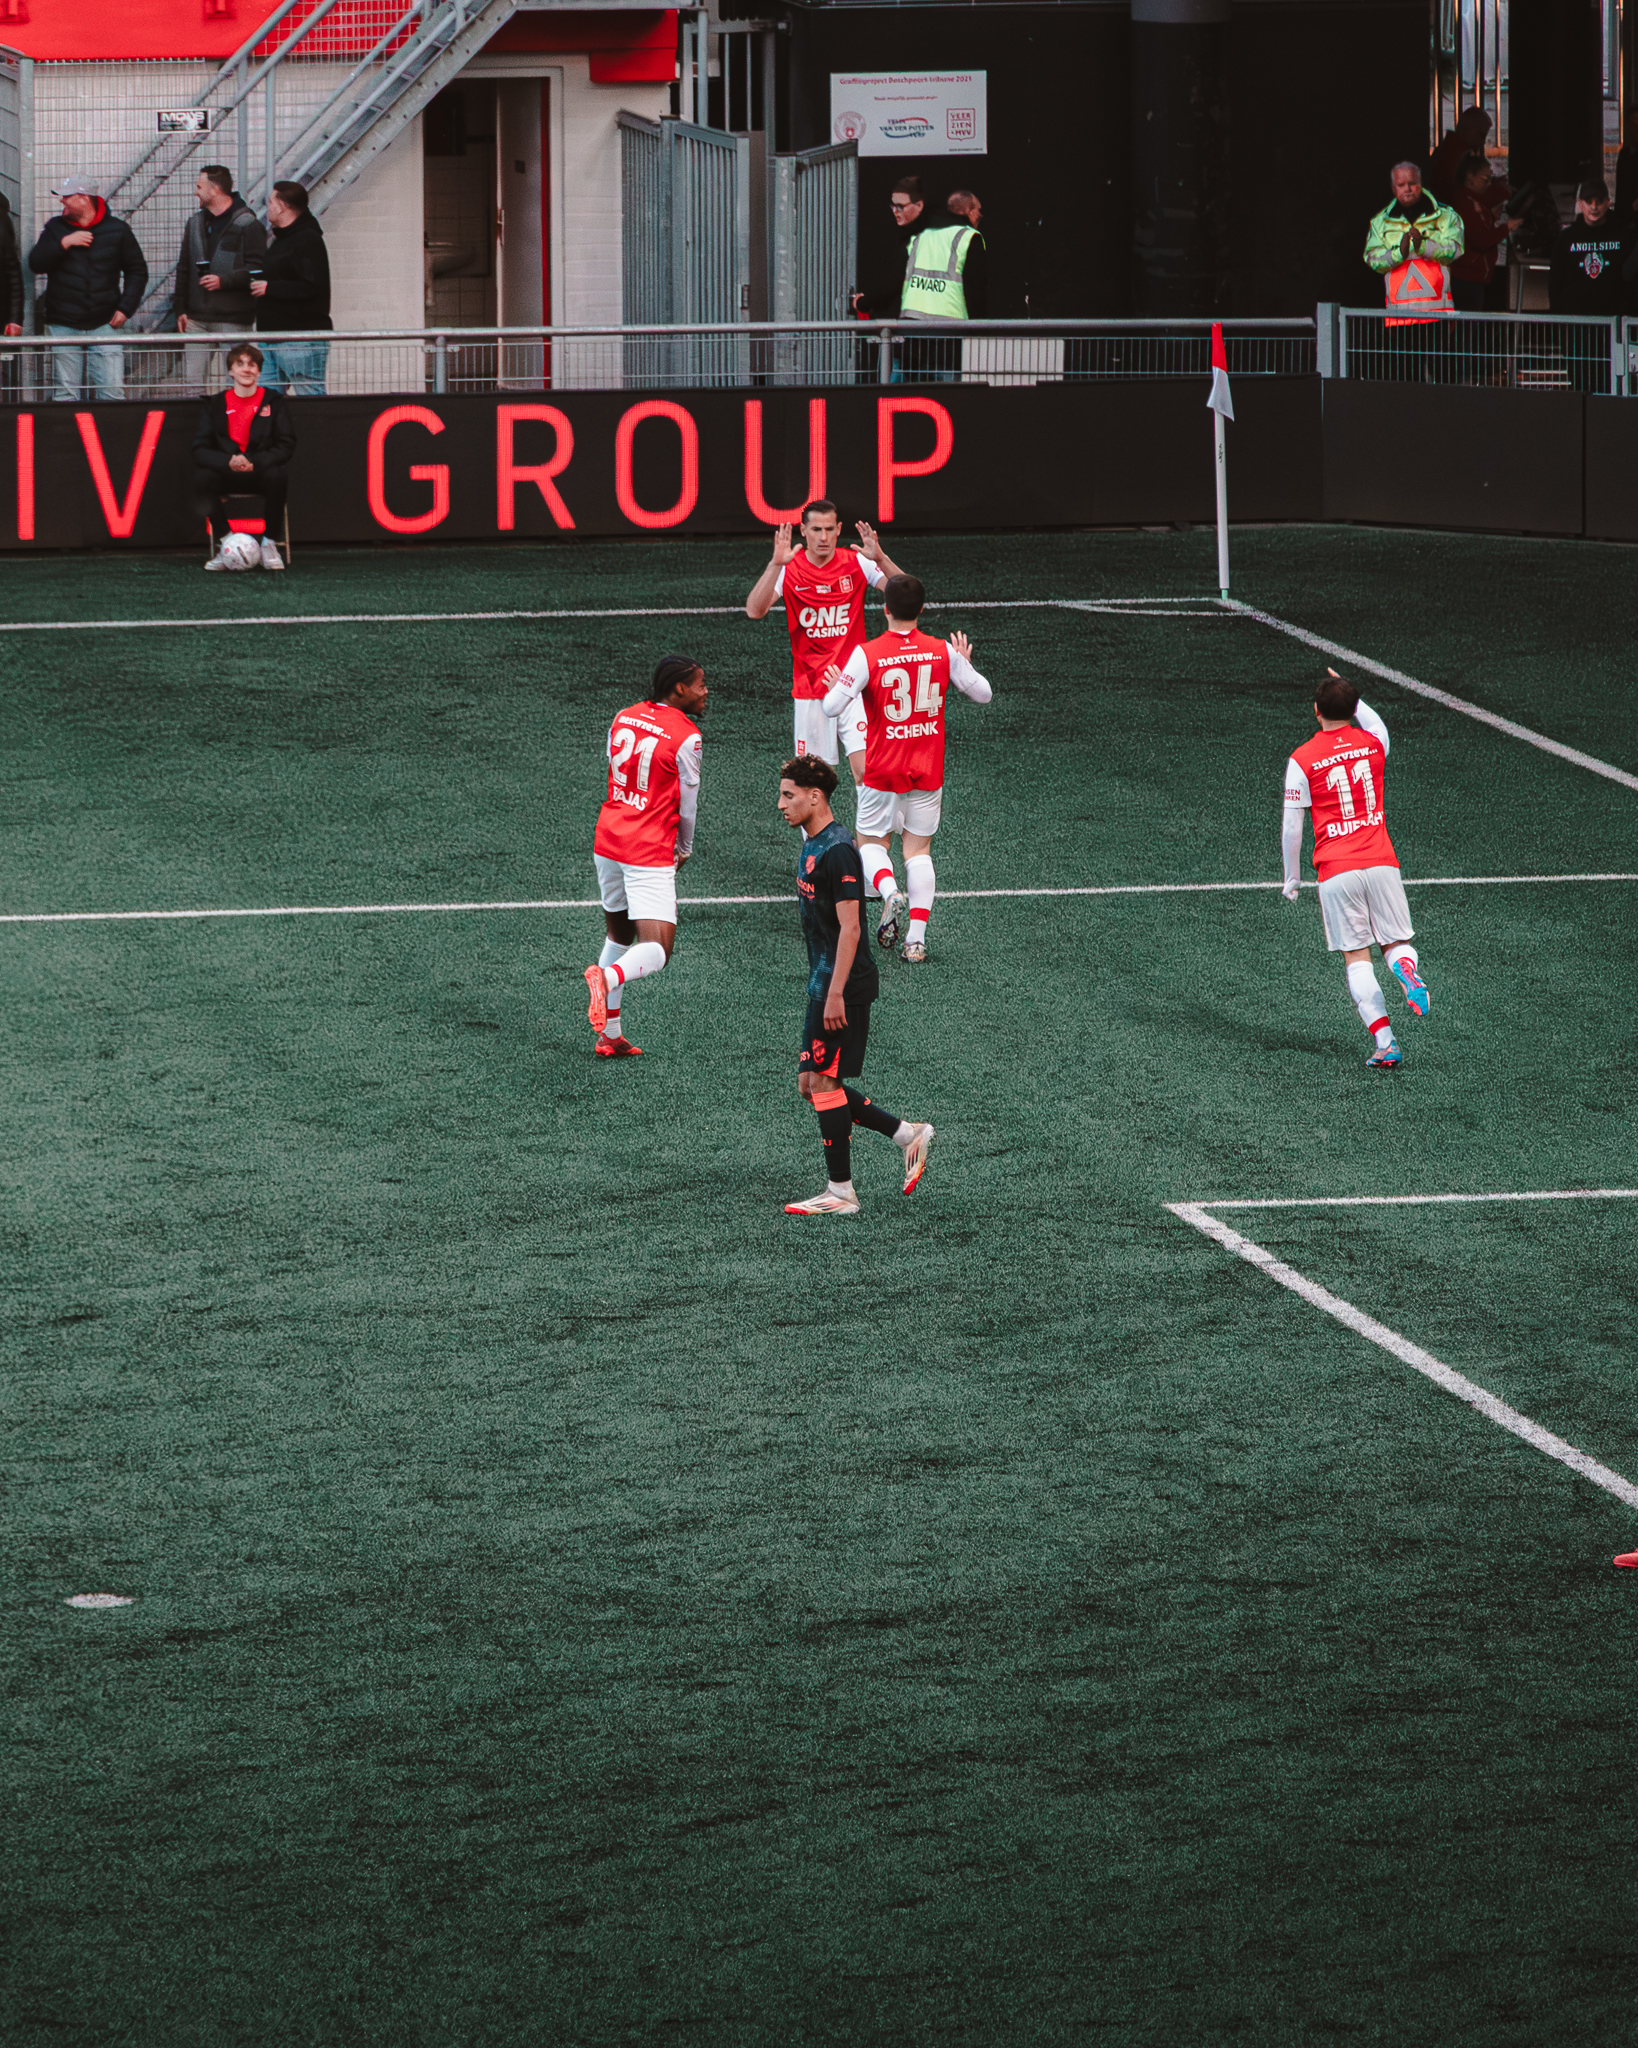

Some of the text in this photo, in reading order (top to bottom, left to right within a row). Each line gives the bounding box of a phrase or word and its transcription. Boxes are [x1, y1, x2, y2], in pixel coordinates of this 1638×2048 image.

[17, 397, 954, 540] IV GROUP
[799, 603, 851, 628] ONE
[806, 625, 848, 638] CASINO
[881, 664, 943, 723] 34
[611, 727, 659, 792] 21
[886, 721, 939, 740] SCHENK
[1326, 759, 1377, 820] 11
